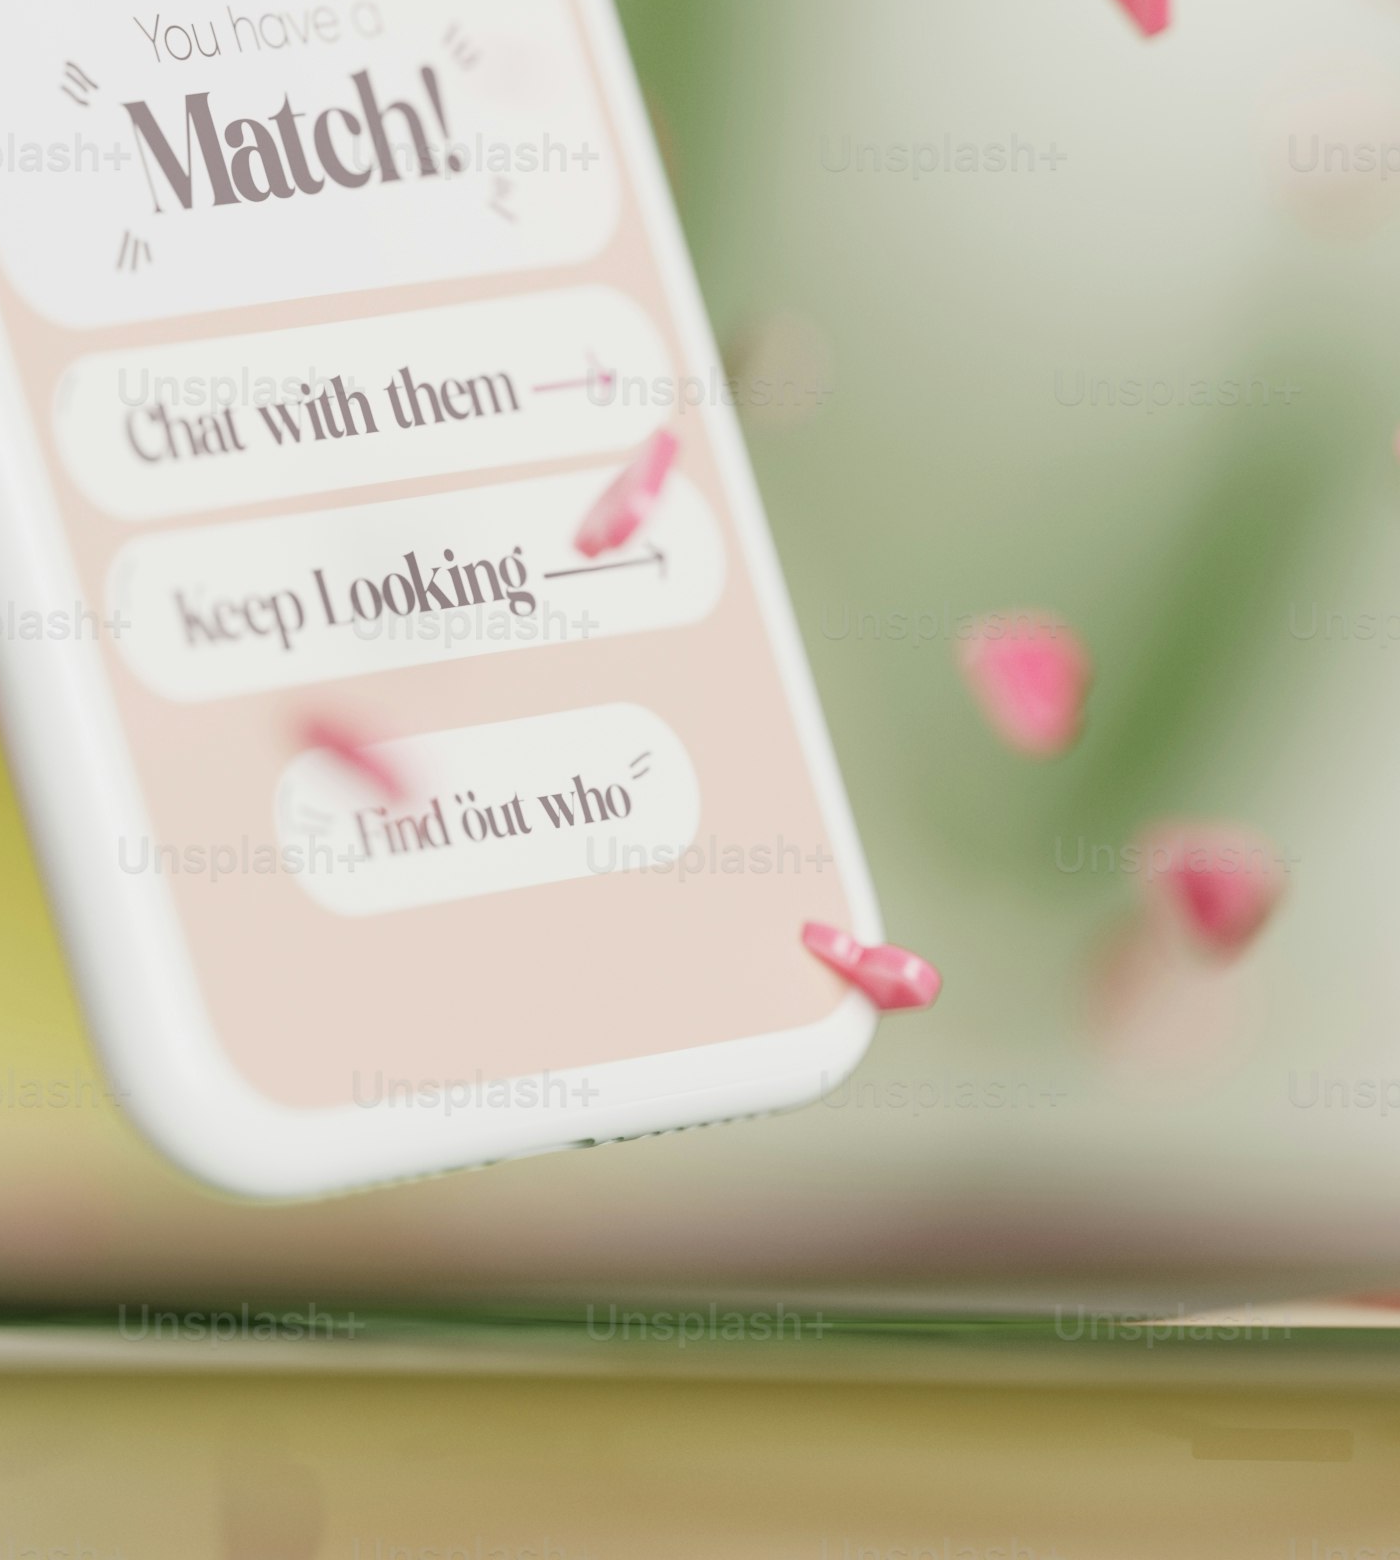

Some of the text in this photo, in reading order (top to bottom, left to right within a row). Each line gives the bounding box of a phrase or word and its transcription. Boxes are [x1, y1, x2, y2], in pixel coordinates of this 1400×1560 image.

[133, 14, 221, 63] You
[227, 6, 339, 52] have
[122, 65, 466, 213] Match!
[125, 366, 521, 462] Chat with them
[174, 545, 537, 651] Keep Looking
[355, 797, 452, 857] Find
[537, 774, 632, 828] who
